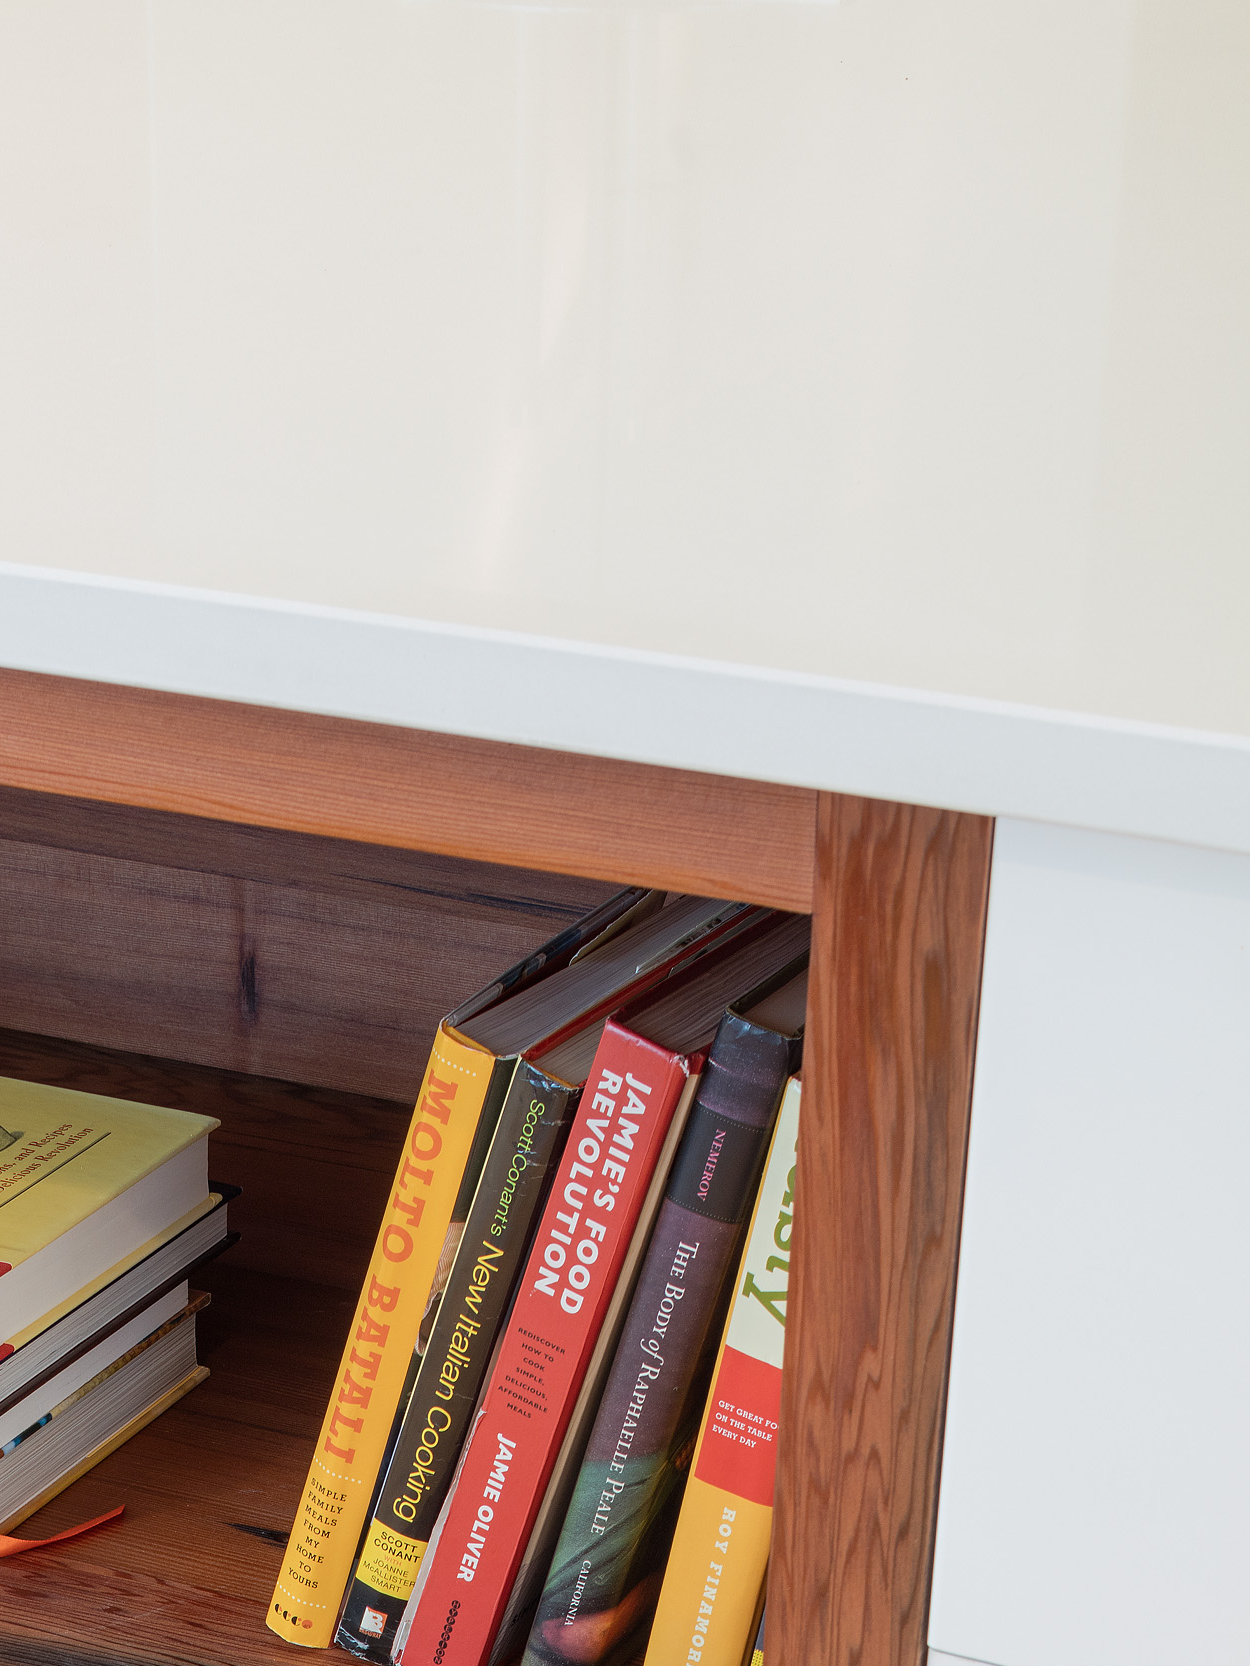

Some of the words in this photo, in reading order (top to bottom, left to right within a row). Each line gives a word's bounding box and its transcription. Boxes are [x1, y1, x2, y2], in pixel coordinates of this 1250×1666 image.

[15, 1147, 35, 1161] and
[29, 1124, 72, 1148] Recipes
[37, 1128, 93, 1162] Revolution
[593, 1073, 652, 1212] JAMIE'S
[382, 1069, 458, 1263] MOLTO
[697, 1129, 726, 1201] NEMEROV
[534, 1068, 623, 1296] REVOLUTION
[560, 1218, 606, 1314] FOOD
[670, 1241, 700, 1279] THE
[465, 1240, 504, 1314] New
[518, 1328, 565, 1355] REDISCOVER
[522, 1343, 541, 1355] HOW
[544, 1354, 554, 1362] TO
[640, 1339, 664, 1366] of
[324, 1274, 401, 1464] BATALI
[435, 1314, 481, 1400] Italian
[523, 1358, 545, 1371] COOK
[505, 1375, 548, 1400] DELICIOUS,
[516, 1367, 544, 1386] SIMPLE,
[498, 1386, 548, 1413] AFFORDABLE
[507, 1403, 531, 1418] MEALS
[719, 1400, 735, 1412] GET
[737, 1409, 763, 1424] GREAT
[712, 1424, 738, 1440] EVERY
[739, 1436, 756, 1448] DAY
[715, 1413, 728, 1423] ON
[730, 1419, 745, 1430] THE
[748, 1426, 772, 1441] TABLE
[393, 1407, 452, 1523] Cooking
[483, 1434, 516, 1502] JAMIE
[308, 1491, 343, 1514] FAMILY
[311, 1478, 347, 1502] SIMPLE
[304, 1519, 330, 1538] FROM
[305, 1505, 337, 1527] MEALS
[306, 1536, 319, 1548] MY
[381, 1531, 418, 1553] SCOTT
[457, 1505, 493, 1582] OLIVER
[715, 1507, 736, 1554] ROY
[296, 1544, 324, 1564] HOME
[374, 1539, 420, 1563] CONANT
[288, 1568, 319, 1589] YOURS
[299, 1561, 311, 1572] TO
[373, 1559, 409, 1577] JOANNE
[371, 1575, 401, 1592] SMART
[564, 1560, 591, 1626] CALIFORNIA
